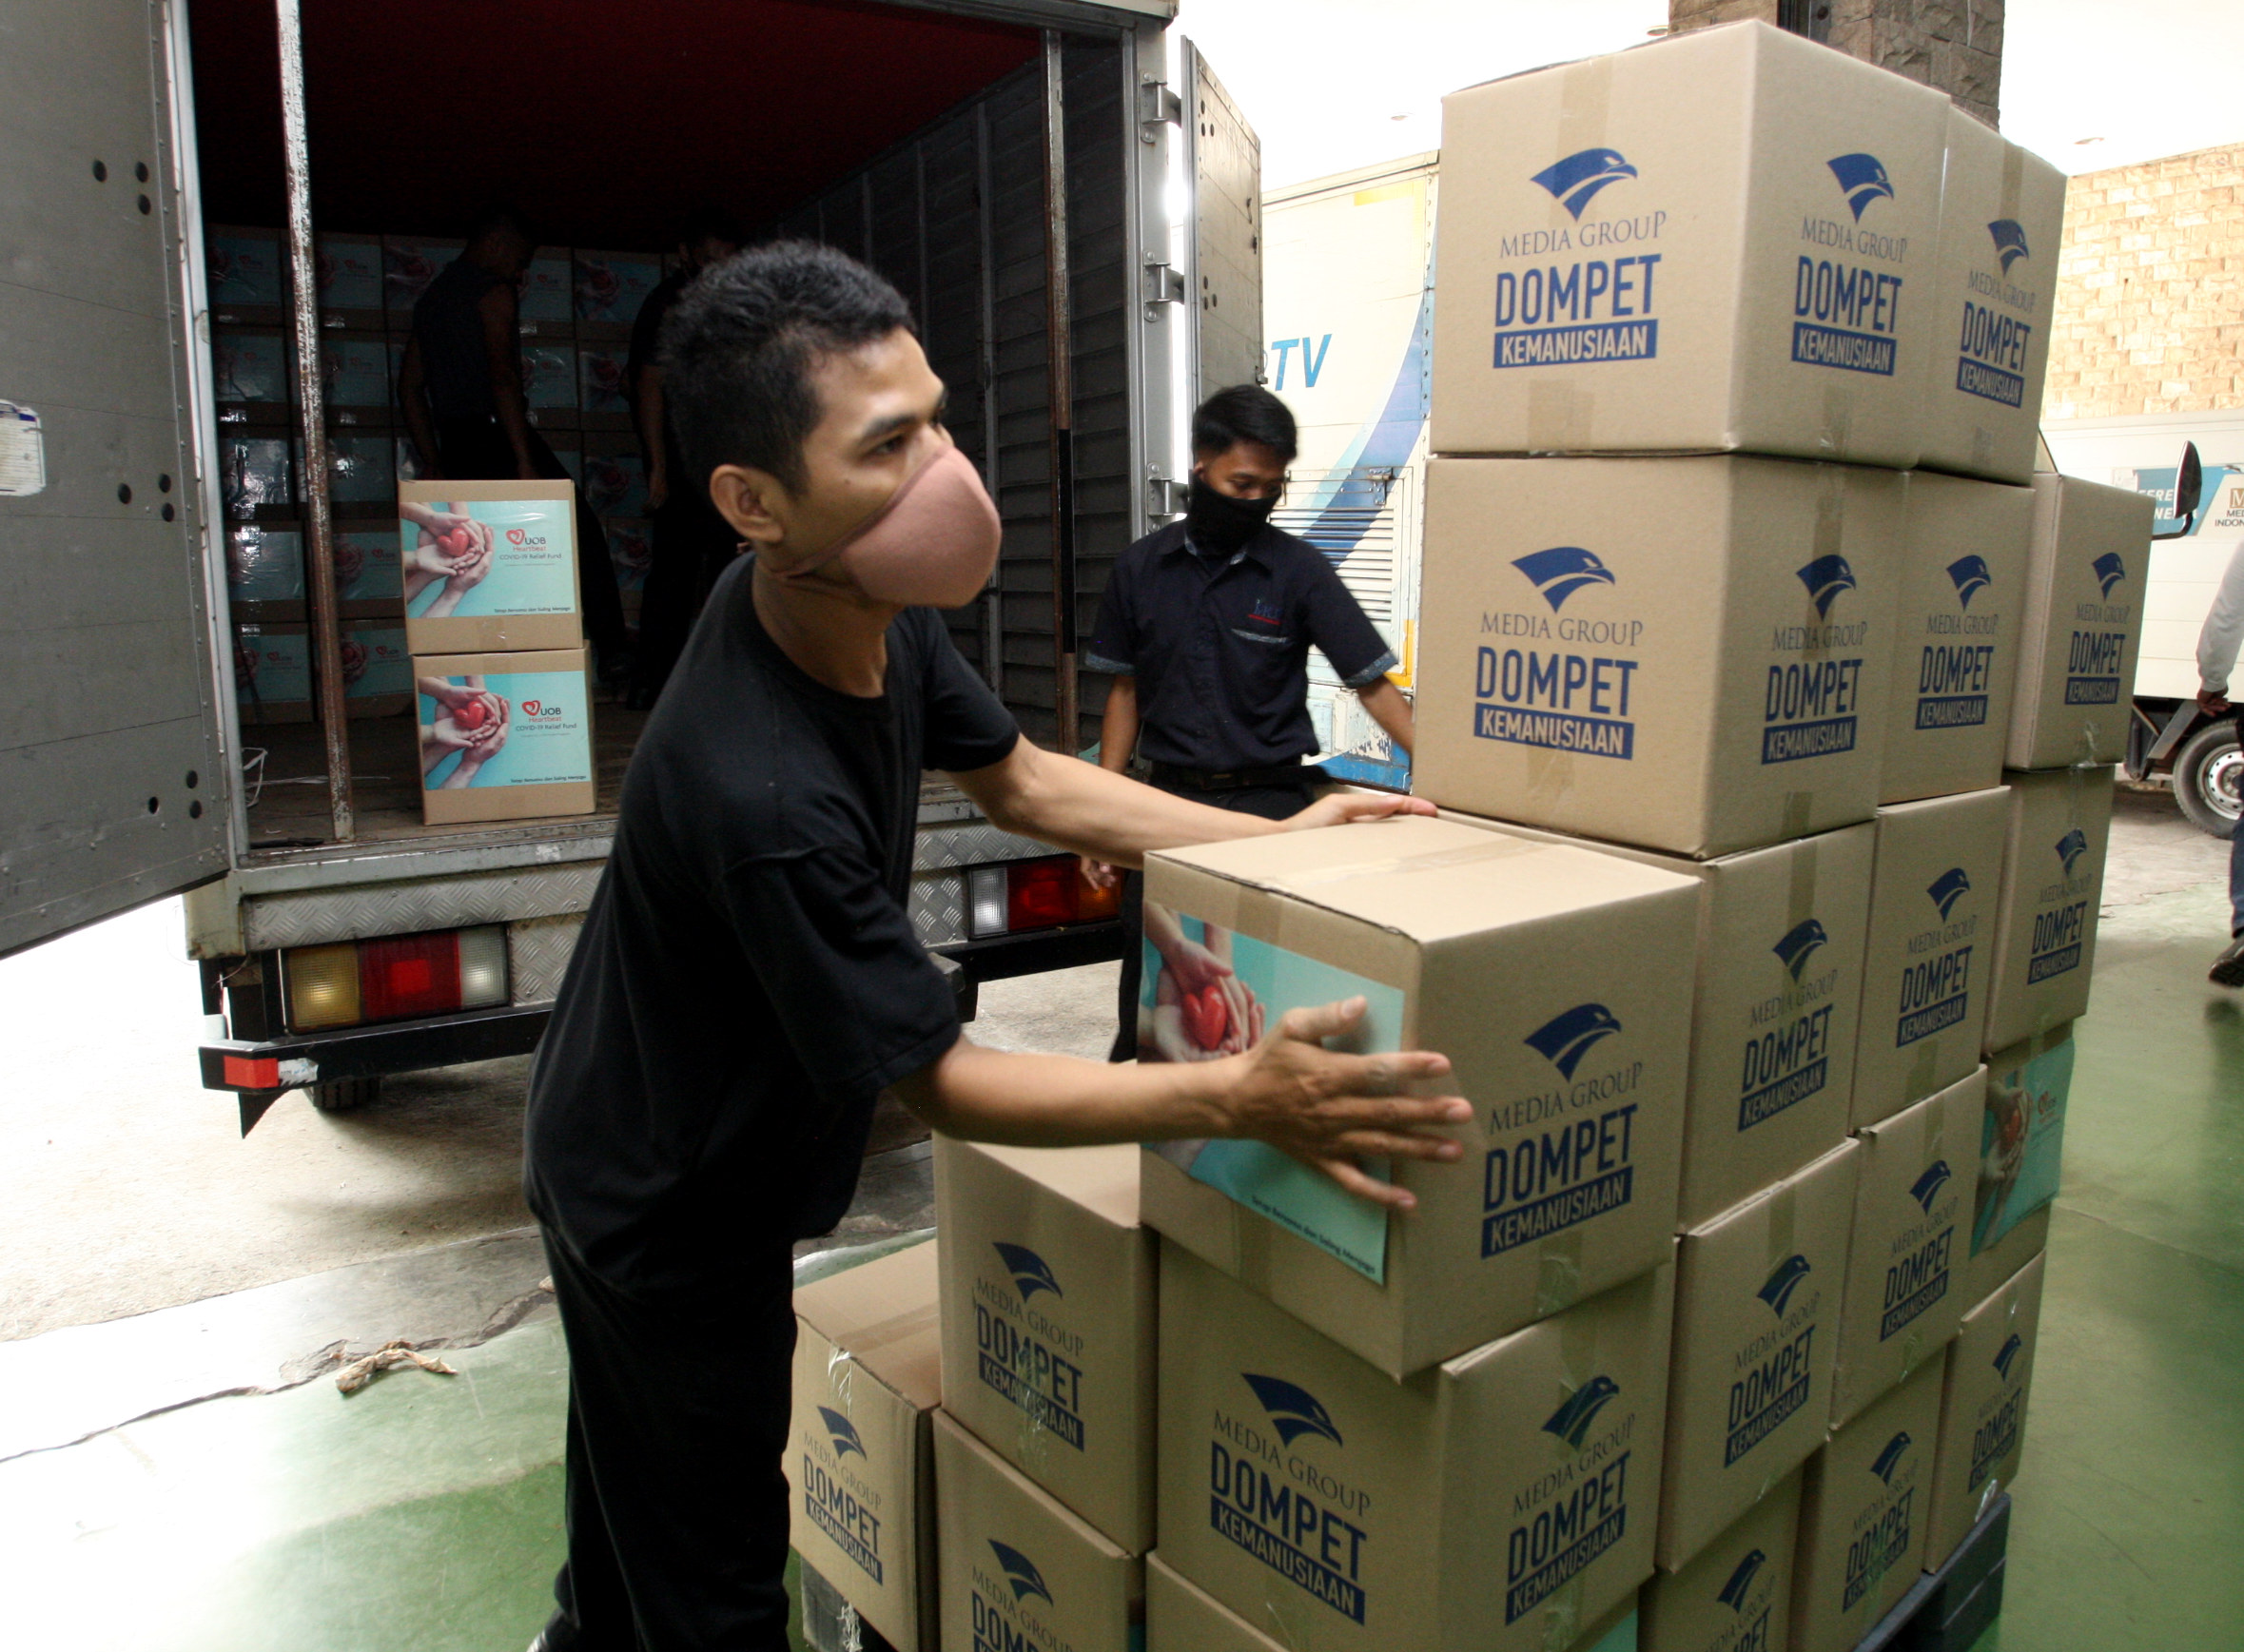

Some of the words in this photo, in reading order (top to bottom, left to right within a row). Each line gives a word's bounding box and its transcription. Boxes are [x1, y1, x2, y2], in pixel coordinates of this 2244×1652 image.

[1500, 228, 1571, 258] MEDIA
[1579, 210, 1666, 247] GROUP
[1801, 216, 1853, 252] MEDIA
[1857, 230, 1907, 263] GROUP
[1495, 253, 1662, 327] DOMPET
[1795, 255, 1903, 334] DOMPET
[1967, 267, 2001, 301] MEDIA
[2002, 283, 2036, 314] GROUP
[1263, 334, 1333, 391] TV
[1502, 325, 1647, 364] KEMANUSIAAN
[1798, 327, 1891, 371] KEMANUSIAAN
[1961, 301, 2032, 373] DOMPET
[1961, 362, 2020, 402] KEMANUSIAAN
[1480, 611, 1552, 640] MEDIA
[1558, 618, 1643, 647] GROUP
[1773, 628, 1819, 651] MEDIA
[1823, 621, 1867, 649] GROUP
[2068, 631, 2126, 674] DOMPET
[1476, 646, 1639, 716] DOMPET
[1766, 659, 1863, 723] DOMPET
[1919, 646, 1994, 693] DOMPET
[1481, 708, 1624, 755] KEMANUSIAAN
[1767, 721, 1852, 760] KEMANUSIAAN
[2032, 901, 2087, 955] DOMPET
[1751, 992, 1793, 1028] MEDIA
[1796, 969, 1838, 1007] GROUP
[1900, 944, 1974, 1014] DOMPET
[1743, 1003, 1833, 1094] DOMPET
[1490, 1090, 1563, 1136] MEDIA
[1571, 1062, 1642, 1108] GROUP
[1745, 1065, 1824, 1127] KEMANUSIAAN
[1484, 1103, 1638, 1213] DOMPET
[1492, 1177, 1625, 1253] KEMANUSIAAN
[1884, 1225, 1954, 1310] DOMPET
[971, 1276, 1024, 1323] MEDIA
[1027, 1311, 1083, 1356] GROUP
[977, 1303, 1083, 1412] DOMPET
[1728, 1324, 1816, 1433] DOMPET
[1731, 1382, 1805, 1463] KEMANUSIAAN
[804, 1431, 838, 1475] MEDIA
[841, 1466, 882, 1511] GROUP
[1215, 1408, 1281, 1469] MEDIA
[1288, 1456, 1370, 1516] GROUP
[1513, 1464, 1573, 1518] MEDIA
[1579, 1413, 1635, 1471] GROUP
[804, 1453, 881, 1555] DOMPET
[809, 1498, 877, 1579] KEMANUSIAAN
[1211, 1440, 1367, 1583] DOMPET
[1508, 1449, 1631, 1585] DOMPET
[1846, 1486, 1914, 1584] DOMPET
[971, 1565, 1017, 1620] MEDIA
[1219, 1504, 1355, 1618] KEMANUSIAAN
[1513, 1516, 1619, 1616] KEMANUSIAAN
